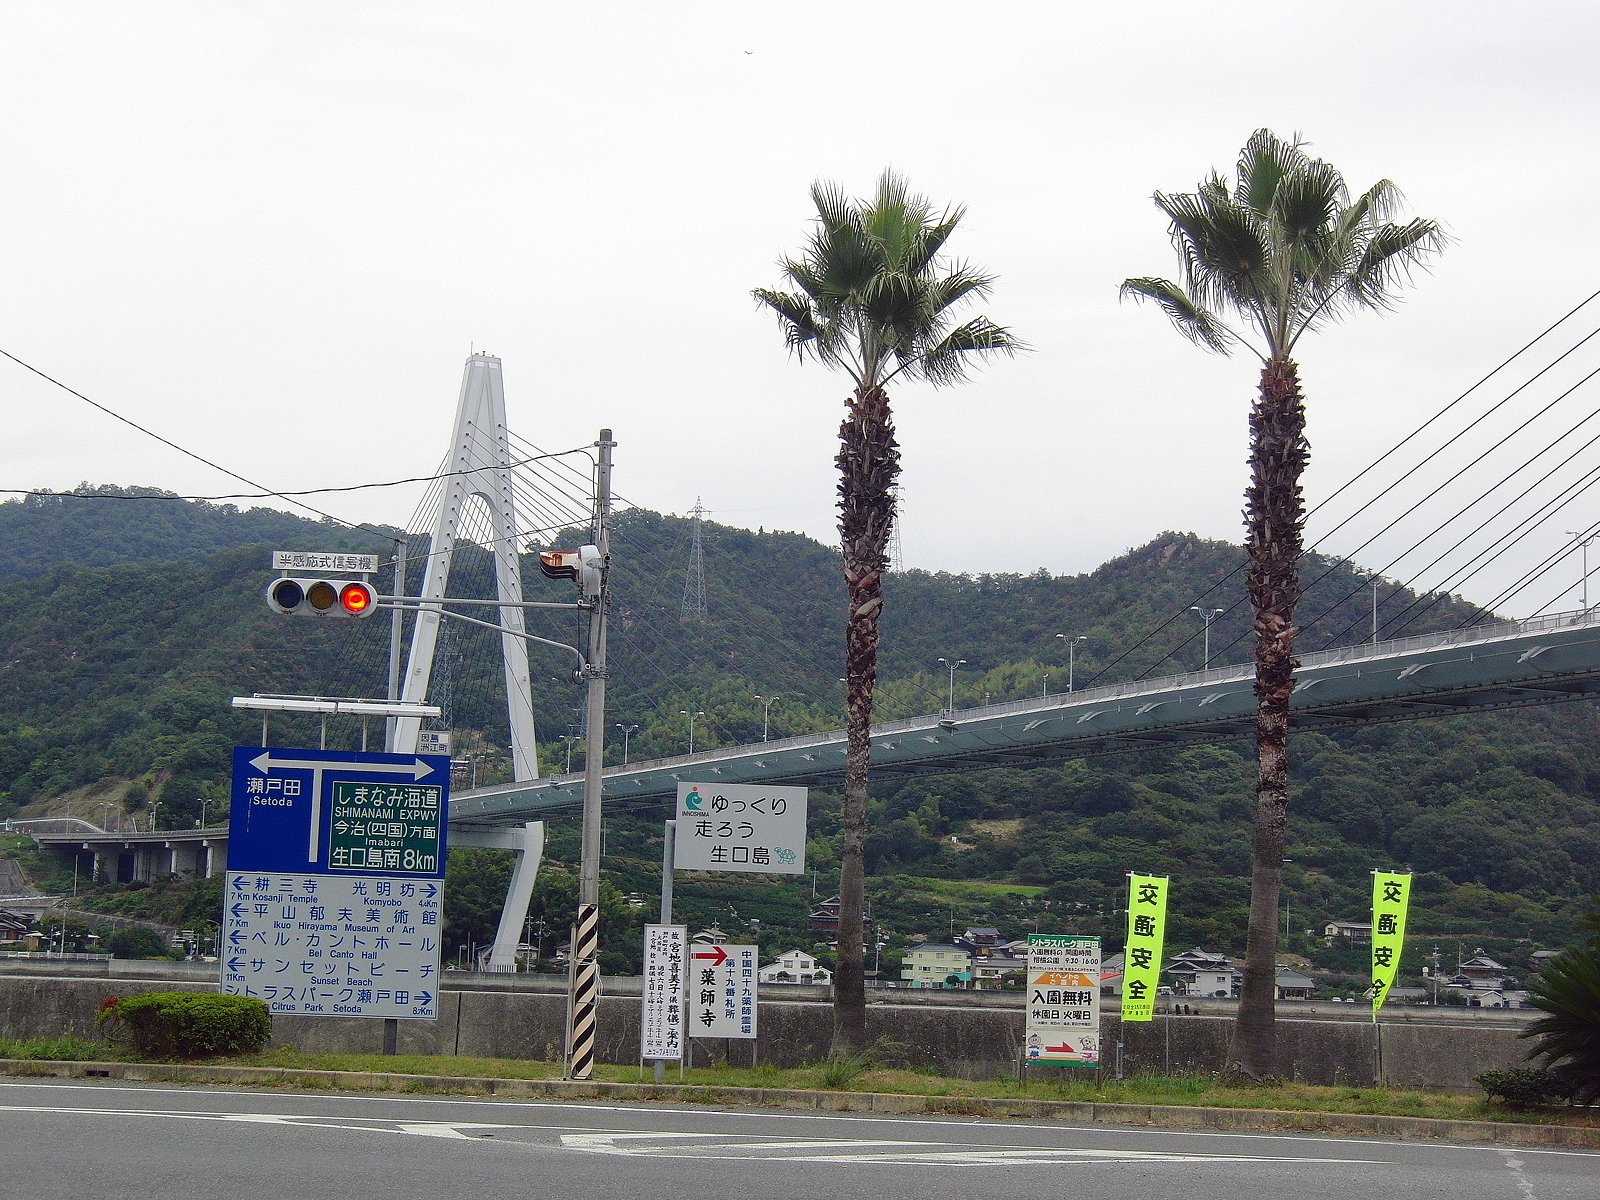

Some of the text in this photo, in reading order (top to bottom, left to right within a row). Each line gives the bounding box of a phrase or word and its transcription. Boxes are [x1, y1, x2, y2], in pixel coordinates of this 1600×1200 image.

[280, 554, 371, 569] 半感応式信号機
[247, 777, 300, 796] 瀬戸田
[254, 796, 292, 806] Setoda
[339, 786, 438, 808] しまなみ海道
[712, 795, 786, 815] ゆっくり
[335, 807, 437, 821] SHIMANAMI EXPWY
[694, 820, 754, 838] 走ろう
[365, 838, 403, 847] Imabari
[332, 846, 434, 869] 生口島南 8km
[710, 845, 769, 865] 生口島
[255, 877, 318, 894] 耕三寺
[352, 882, 415, 897] 光明坊
[252, 894, 318, 903] Kosanji Temple
[364, 897, 402, 907] Komyobo
[254, 904, 436, 925] 平山郁夫美術館
[274, 921, 415, 934] Ikuo Hirayama Museum of Art
[330, 950, 354, 958] Canto
[362, 952, 377, 960] Hall
[250, 958, 434, 978] サンセットビーチ
[311, 976, 372, 986] Sunset Beach
[725, 959, 735, 1019] 第十九番札所
[741, 951, 751, 1034] 中国四十九薬師霊場
[700, 968, 716, 1028] 薬師寺
[1032, 990, 1092, 1005] 入園無料
[272, 1002, 362, 1013] Citrus Park Setoda
[1032, 1009, 1090, 1020] 休園日 火曜日
